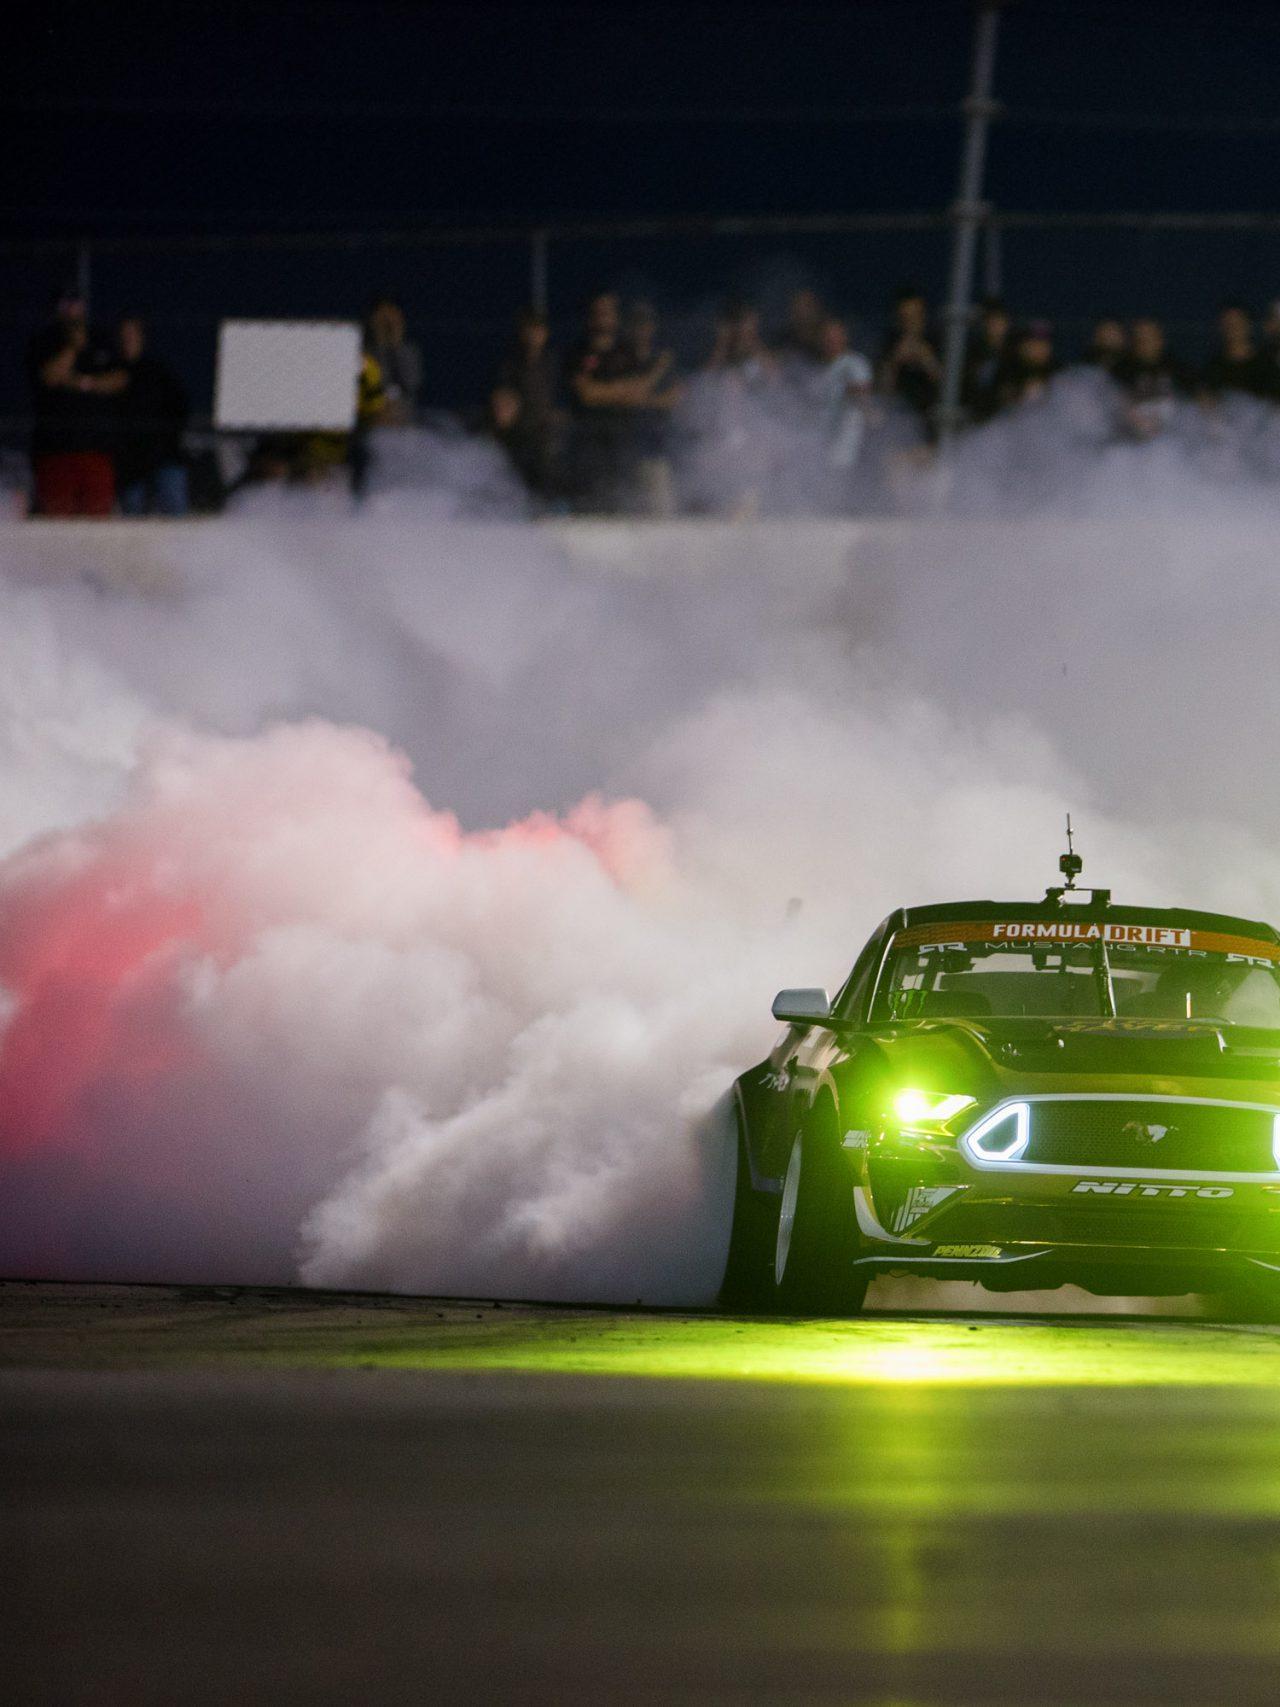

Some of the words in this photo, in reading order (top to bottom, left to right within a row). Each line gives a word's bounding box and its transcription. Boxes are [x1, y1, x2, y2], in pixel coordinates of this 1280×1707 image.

[993, 923, 1100, 938] FORMULA
[1109, 926, 1186, 945] DRIFT
[985, 941, 1136, 952] MUSTANG
[1147, 945, 1208, 958] RTR
[1072, 1181, 1234, 1198] NITTO
